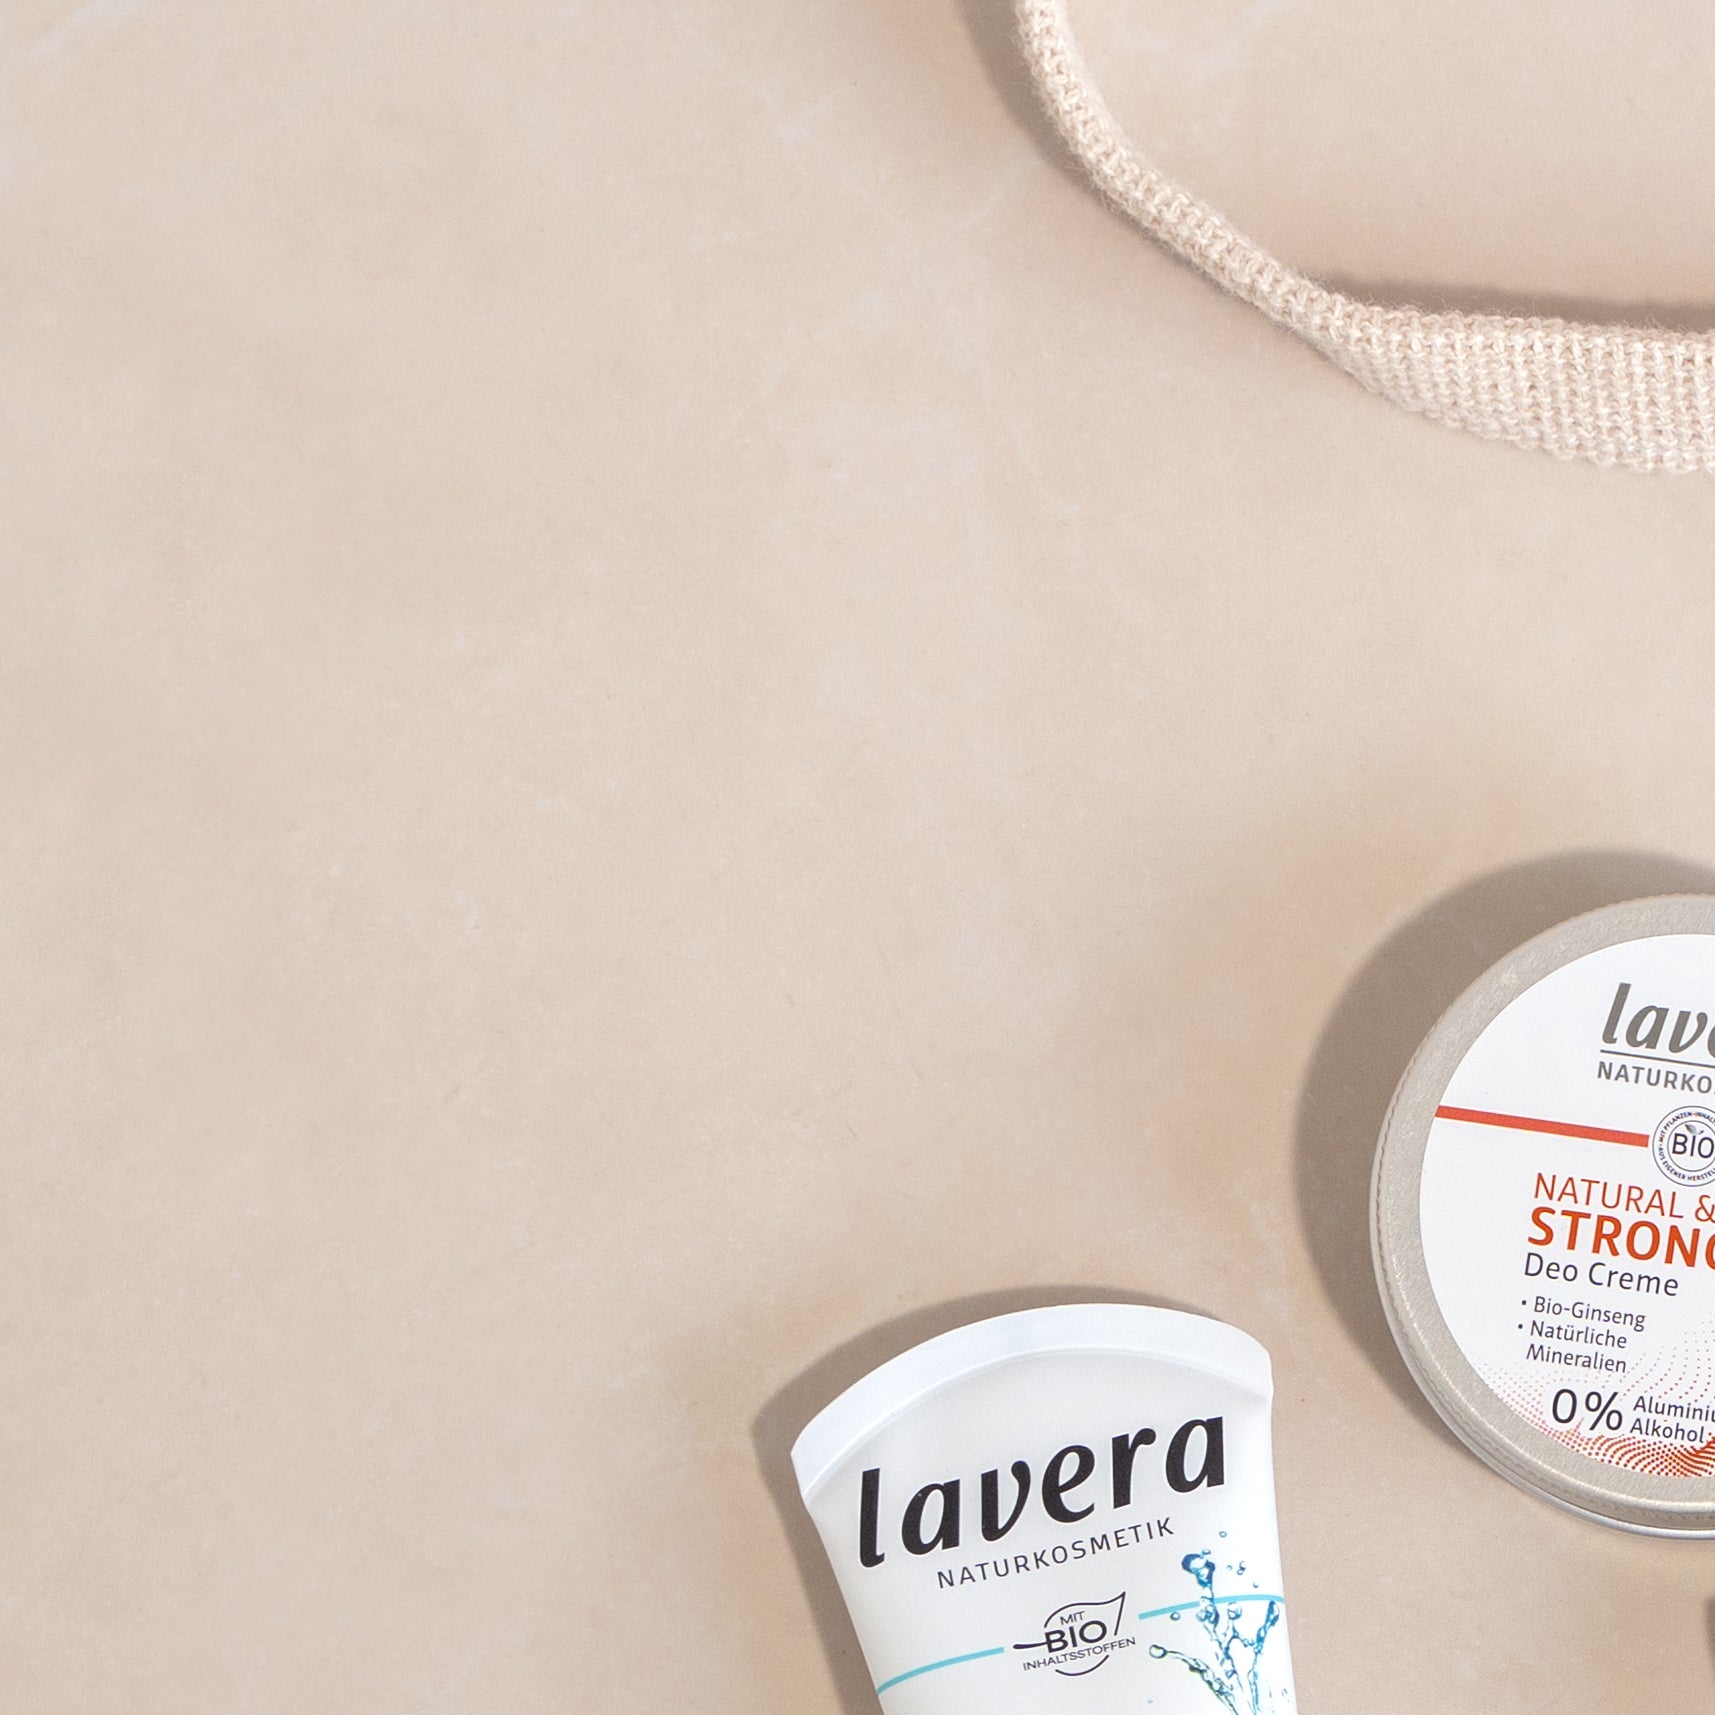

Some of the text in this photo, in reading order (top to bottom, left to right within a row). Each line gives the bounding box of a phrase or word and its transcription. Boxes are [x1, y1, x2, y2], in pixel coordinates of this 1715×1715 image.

[1672, 1132, 1715, 1159] BIO
[1534, 1172, 1684, 1219] NATURAL
[1524, 1252, 1679, 1296] Deo Creme
[1534, 1296, 1646, 1332] Bio-Ginseng
[1530, 1320, 1627, 1349] Natürliche
[1526, 1344, 1627, 1373] Mineralien
[1552, 1388, 1623, 1431] 0%
[1630, 1418, 1705, 1443] Alkohol
[859, 1415, 1225, 1568] lavera
[937, 1516, 1175, 1589] NATURKOSMETIK
[1060, 1610, 1085, 1625] MIT
[1045, 1620, 1107, 1653] BIO
[1023, 1637, 1136, 1671] INHALTSSTOFFEN
